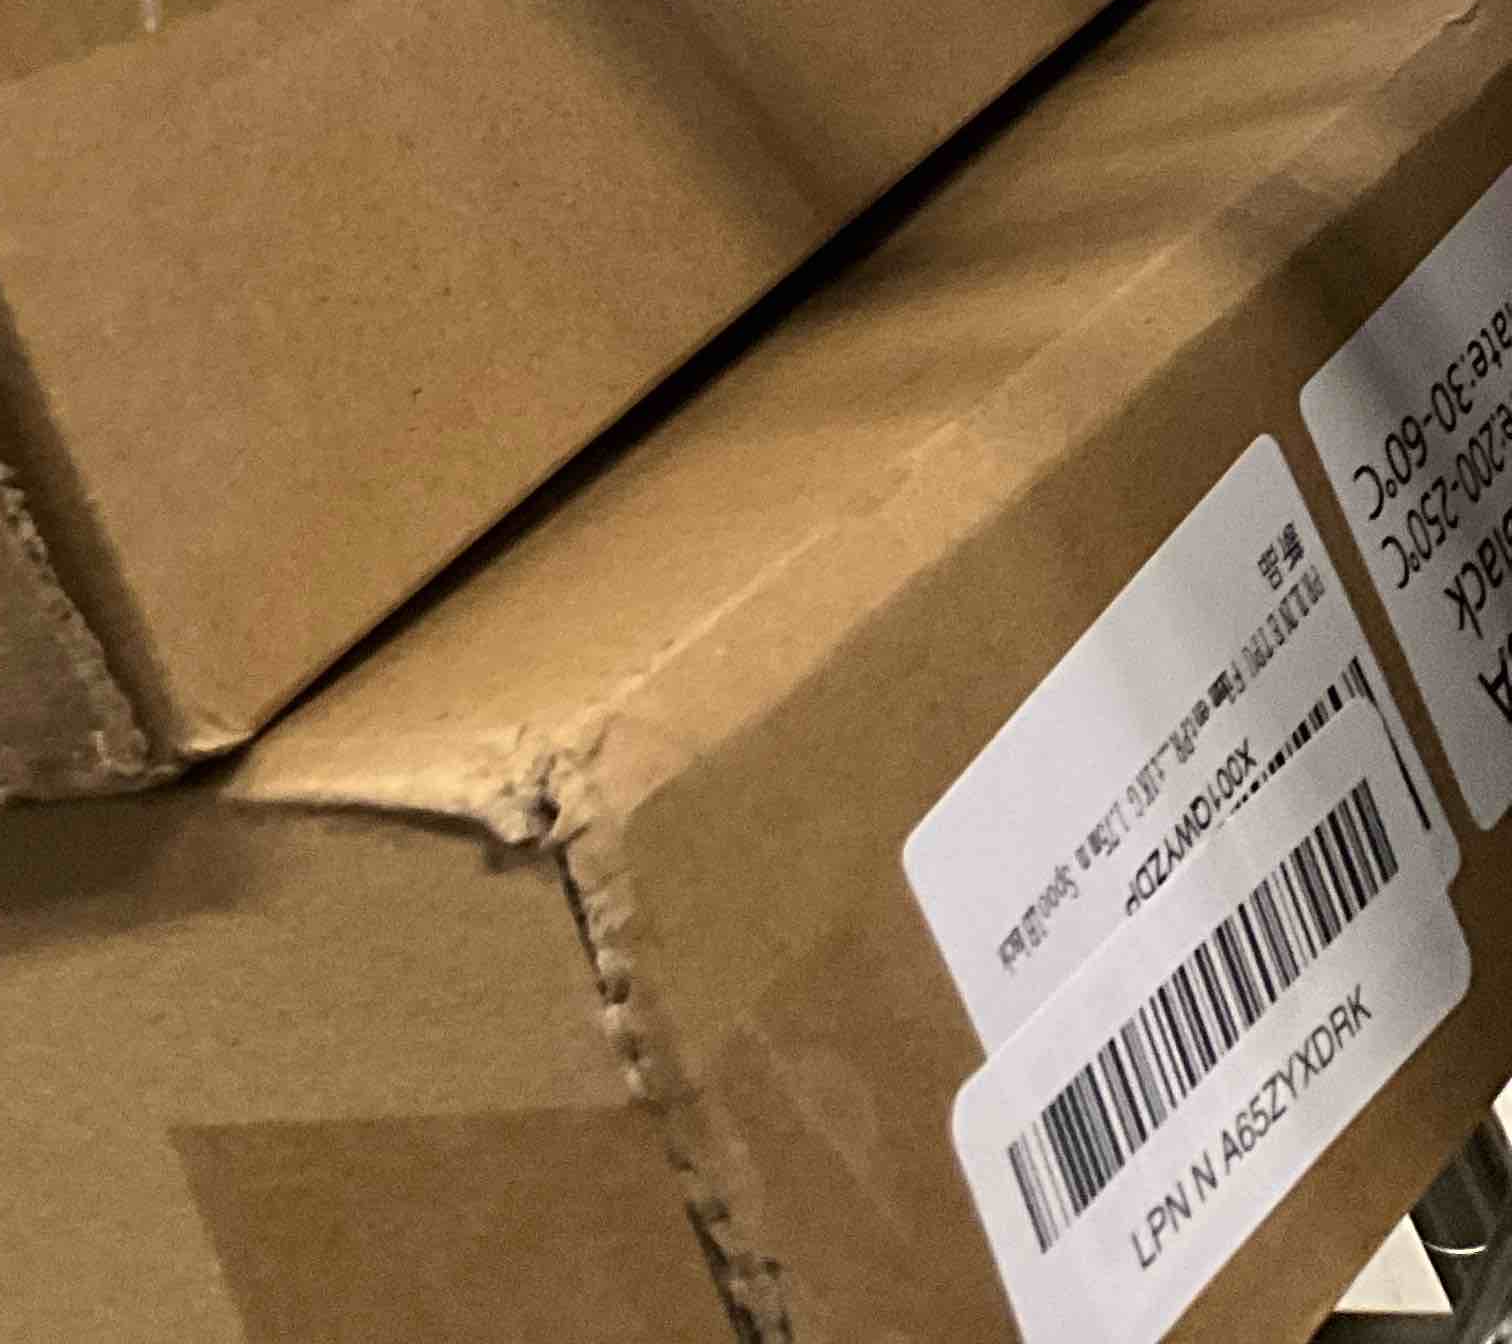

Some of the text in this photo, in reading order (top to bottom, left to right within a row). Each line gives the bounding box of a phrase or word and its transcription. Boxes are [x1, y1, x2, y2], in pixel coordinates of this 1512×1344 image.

[1131, 983, 1373, 1271] LPN N A65ZYXDRK
